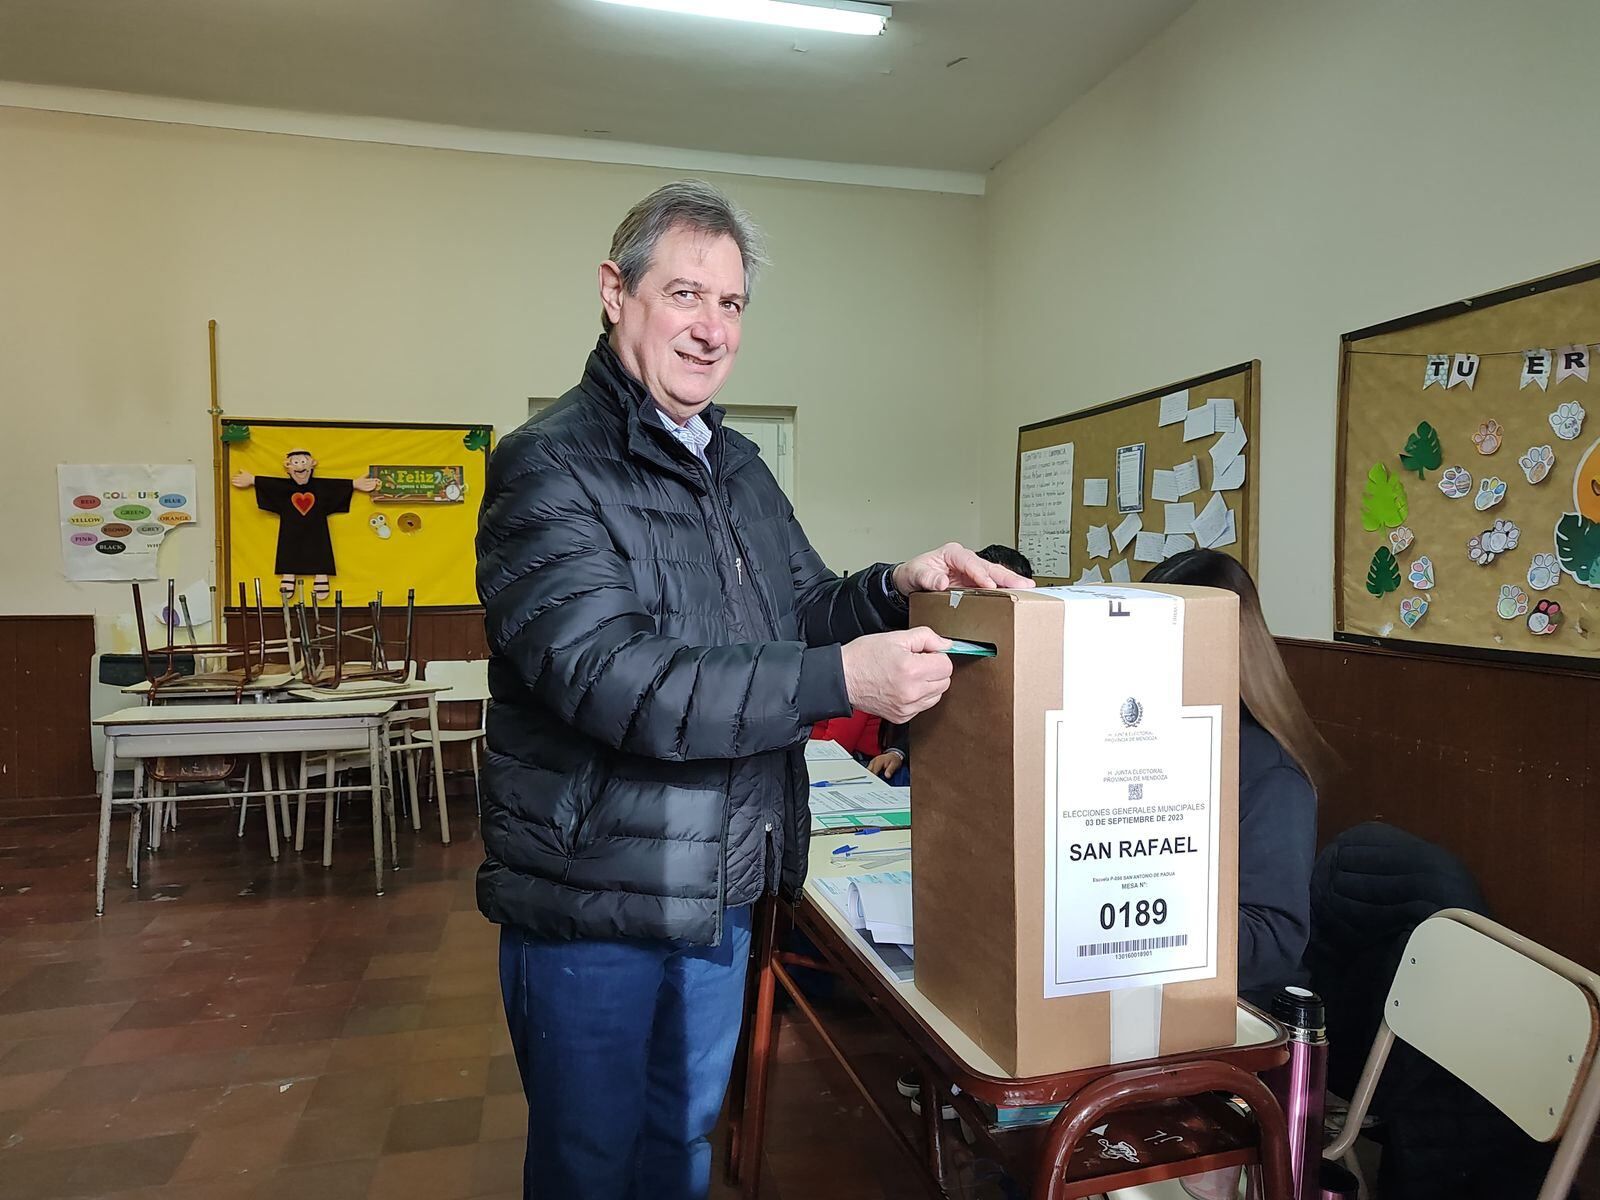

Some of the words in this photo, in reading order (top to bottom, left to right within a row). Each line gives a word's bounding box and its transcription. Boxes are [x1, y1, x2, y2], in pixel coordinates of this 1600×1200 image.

[397, 470, 434, 483] Feliz
[103, 491, 160, 500] COLOURS
[1062, 808, 1111, 818] ELECCIONES
[1114, 806, 1157, 816] GENERALES
[1157, 803, 1206, 813] MUNICIPALES
[1085, 819, 1094, 827] 03
[1095, 818, 1106, 826] DE
[1107, 815, 1155, 825] SEPTIEMBRE
[1156, 814, 1166, 822] DE
[1167, 813, 1184, 822] 2023
[1069, 841, 1112, 862] SAN
[1119, 836, 1198, 858] RAFAEL
[1121, 882, 1138, 890] MESA
[1099, 898, 1168, 930] 0189
